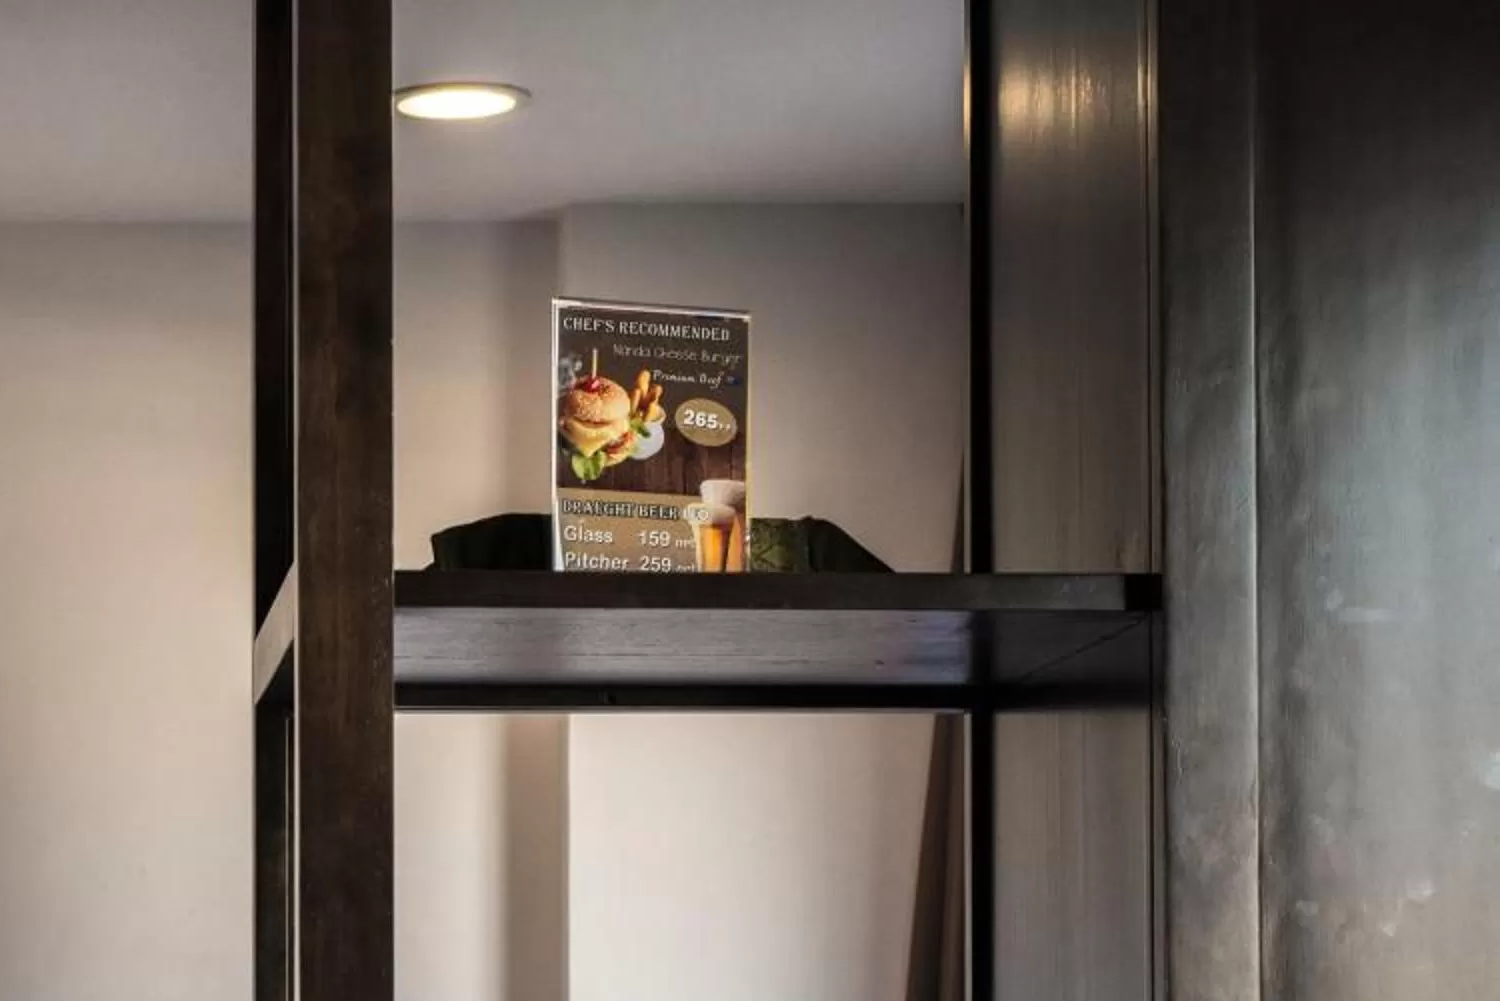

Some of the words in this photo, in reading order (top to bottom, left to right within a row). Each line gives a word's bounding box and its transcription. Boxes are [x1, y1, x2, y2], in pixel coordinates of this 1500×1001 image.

[563, 316, 615, 333] CHEF'S
[619, 321, 730, 341] RECOMMENDED
[563, 524, 614, 543] Glass
[638, 530, 671, 547] 159
[565, 551, 629, 570] Pitcher
[640, 555, 672, 573] 259
